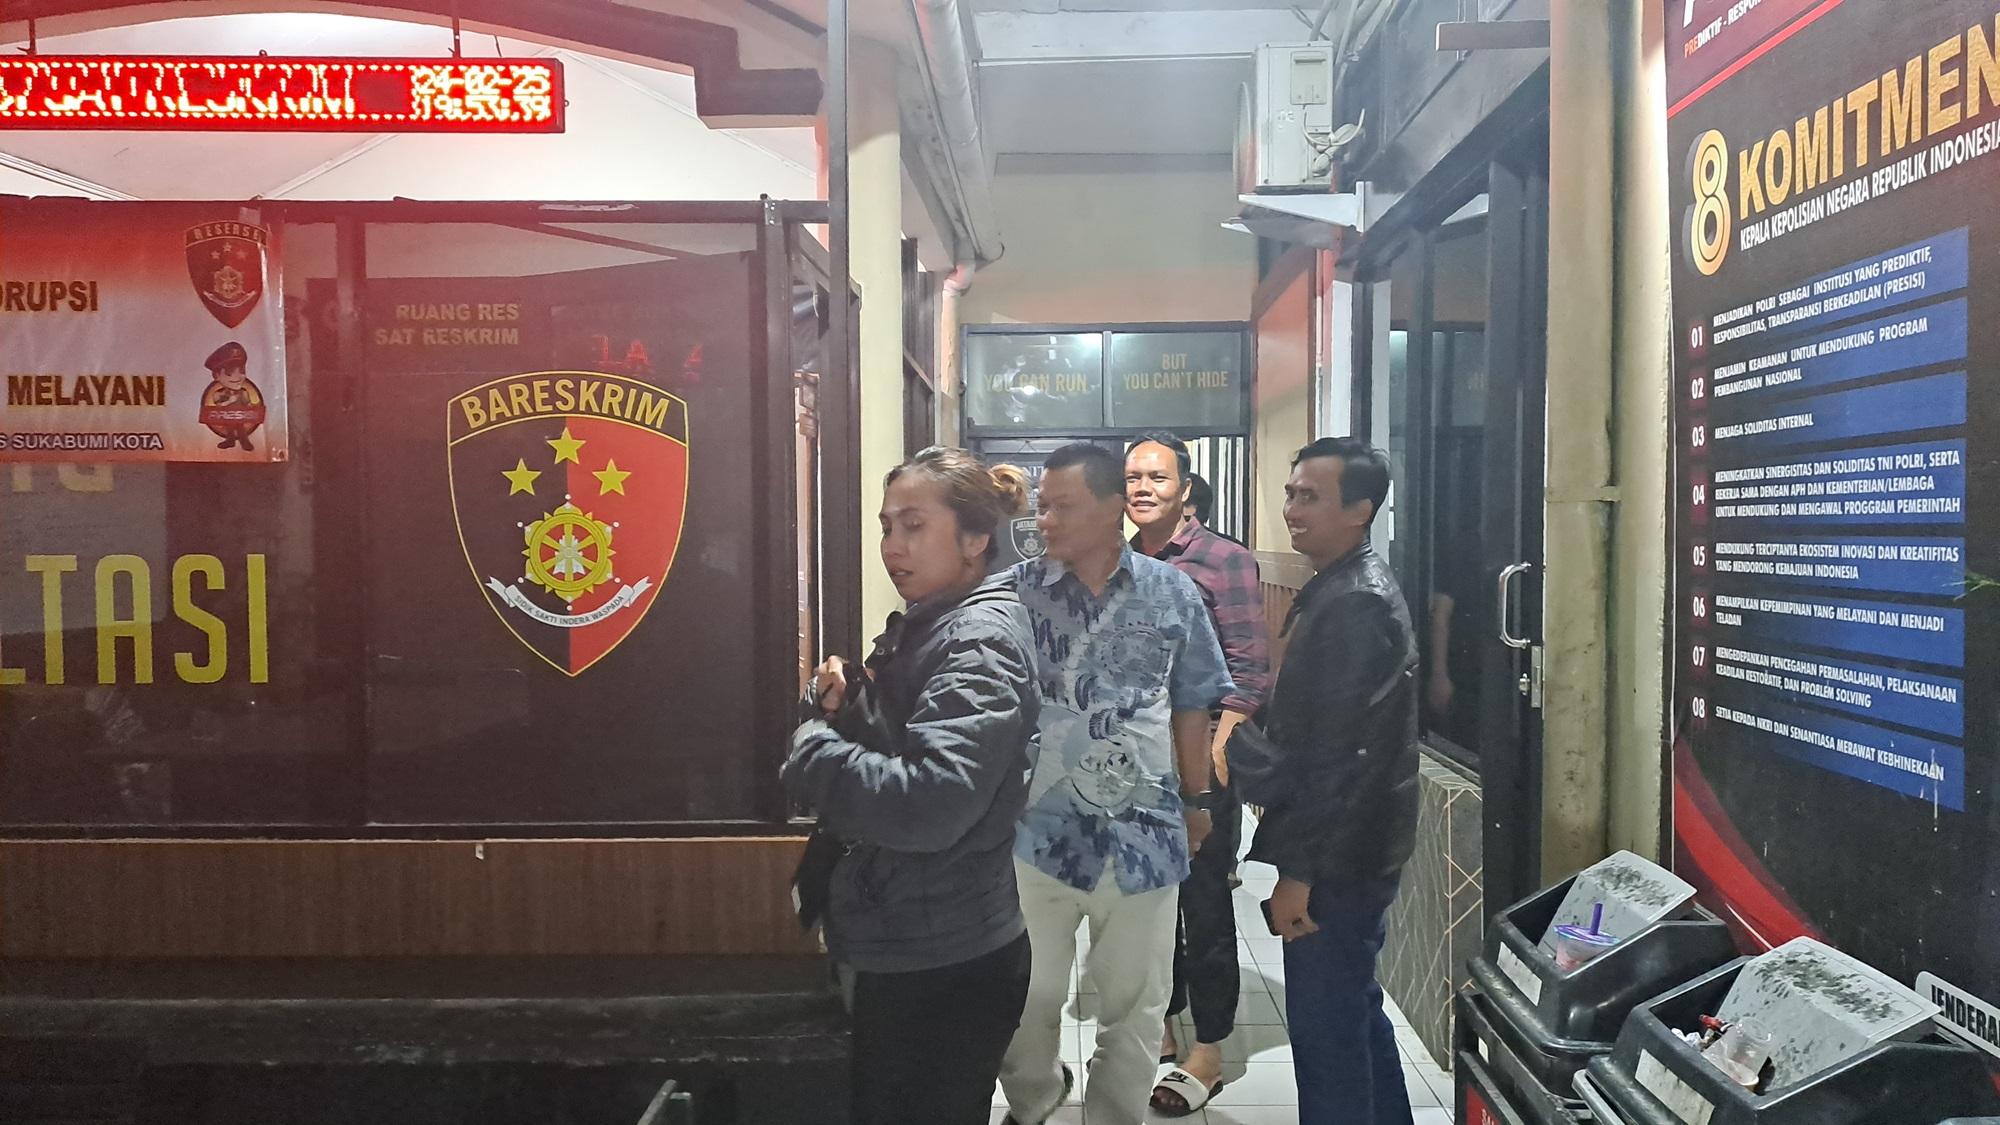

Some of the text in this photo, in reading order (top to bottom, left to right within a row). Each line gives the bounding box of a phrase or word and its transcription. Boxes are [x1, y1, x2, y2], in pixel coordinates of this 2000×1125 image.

[1684, 16, 1722, 58] PREDIKTIF
[1728, 0, 1761, 26] RESPO
[1691, 12, 2000, 276] 8 KOMITMEN
[1740, 218, 1770, 251] KEPALA
[1771, 194, 1824, 238] KEPOLISIAN
[1826, 176, 1869, 216] NEGARA
[1872, 150, 1927, 198] REPUBLIK
[193, 223, 260, 240] RESERSE
[1778, 285, 1810, 306] SEBAGAI
[1813, 271, 1853, 295] INSTITUSI
[1854, 263, 1880, 283] YANG
[1882, 246, 1932, 274] PREDIKTIF,
[0, 281, 98, 311] RUPSI
[1768, 301, 1822, 328] TRANSPARANSI
[1823, 284, 1881, 313] BERKEADILAN
[1883, 271, 1926, 300] (PRESISI)
[396, 303, 520, 321] RUANG RES
[375, 328, 519, 345] SAT RESKRIM
[1691, 326, 1703, 348] 01
[1749, 352, 1788, 371] KEAMANAN
[1790, 344, 1817, 362] UNTUK
[1818, 330, 1874, 356] MENDUKUNG
[1879, 317, 1928, 342] PROGRAM
[1162, 353, 1188, 370] BUT
[1055, 374, 1088, 392] RUN
[1123, 371, 1228, 391] YOU CAN'T HIDE
[1765, 368, 1802, 386] NASIONAL
[8, 376, 165, 405] MELAYANI
[1691, 378, 1704, 399] 02
[460, 379, 670, 429] BARESKRIM
[1744, 419, 1777, 435] SOLIDITAS
[1778, 413, 1814, 430] INTERNAL
[13, 435, 108, 449] SUKABUMI
[113, 435, 163, 449] KOTA
[1692, 427, 1705, 448] 03
[1765, 463, 1812, 479] SINERGISITAS
[1813, 461, 1831, 475] DAN
[1833, 457, 1875, 474] SOLIDITAS
[1877, 456, 1893, 470] TNI
[1896, 454, 1927, 470] POLRI,
[1929, 450, 1960, 467] SERTA
[1693, 484, 1705, 505] 04
[1741, 486, 1759, 499] SAMA
[1760, 484, 1789, 498] DENGAN
[1790, 483, 1806, 496] APH
[1807, 482, 1824, 495] DAN
[1826, 475, 1935, 495] KEMENTERIAN/LEMBAGA
[1715, 497, 1960, 518] UNTUK MENDUKUNG DAN MENGAWAL PROGGRAM PEMERINTAH
[1693, 546, 1705, 567] 05
[1800, 544, 1839, 558] EKOSISTEM
[1841, 544, 1875, 559] INOVASI
[1878, 545, 1898, 560] DAN
[1900, 546, 1959, 562] KREATIFITAS
[1715, 560, 1859, 579] YANG MENDORONG KEMAJUAN INDONESIA
[1693, 596, 1706, 618] 06
[1813, 604, 1835, 619] YANG
[1836, 607, 1877, 624] MELAYANI
[1879, 611, 1899, 627] DAN
[1901, 614, 1944, 632] MENJADI
[0, 554, 268, 684] TASI
[1692, 645, 1705, 667] 07
[1770, 656, 1817, 676] PENCEGAHAN
[1819, 664, 1885, 692] PERMASALAHAN,
[1887, 677, 1957, 703] PELAKSANAAN
[1784, 677, 1800, 692] DAN
[1800, 681, 1834, 700] PROBLEM
[1835, 688, 1872, 708] SOLVING
[1692, 697, 1705, 718] 08
[1732, 710, 1756, 727] KEPADA
[1774, 722, 1789, 737] DAN
[1790, 726, 1835, 750] SENANTIASA
[1836, 739, 1876, 761] MERAWAT
[1877, 749, 1944, 781] KEBHINEKAAN
